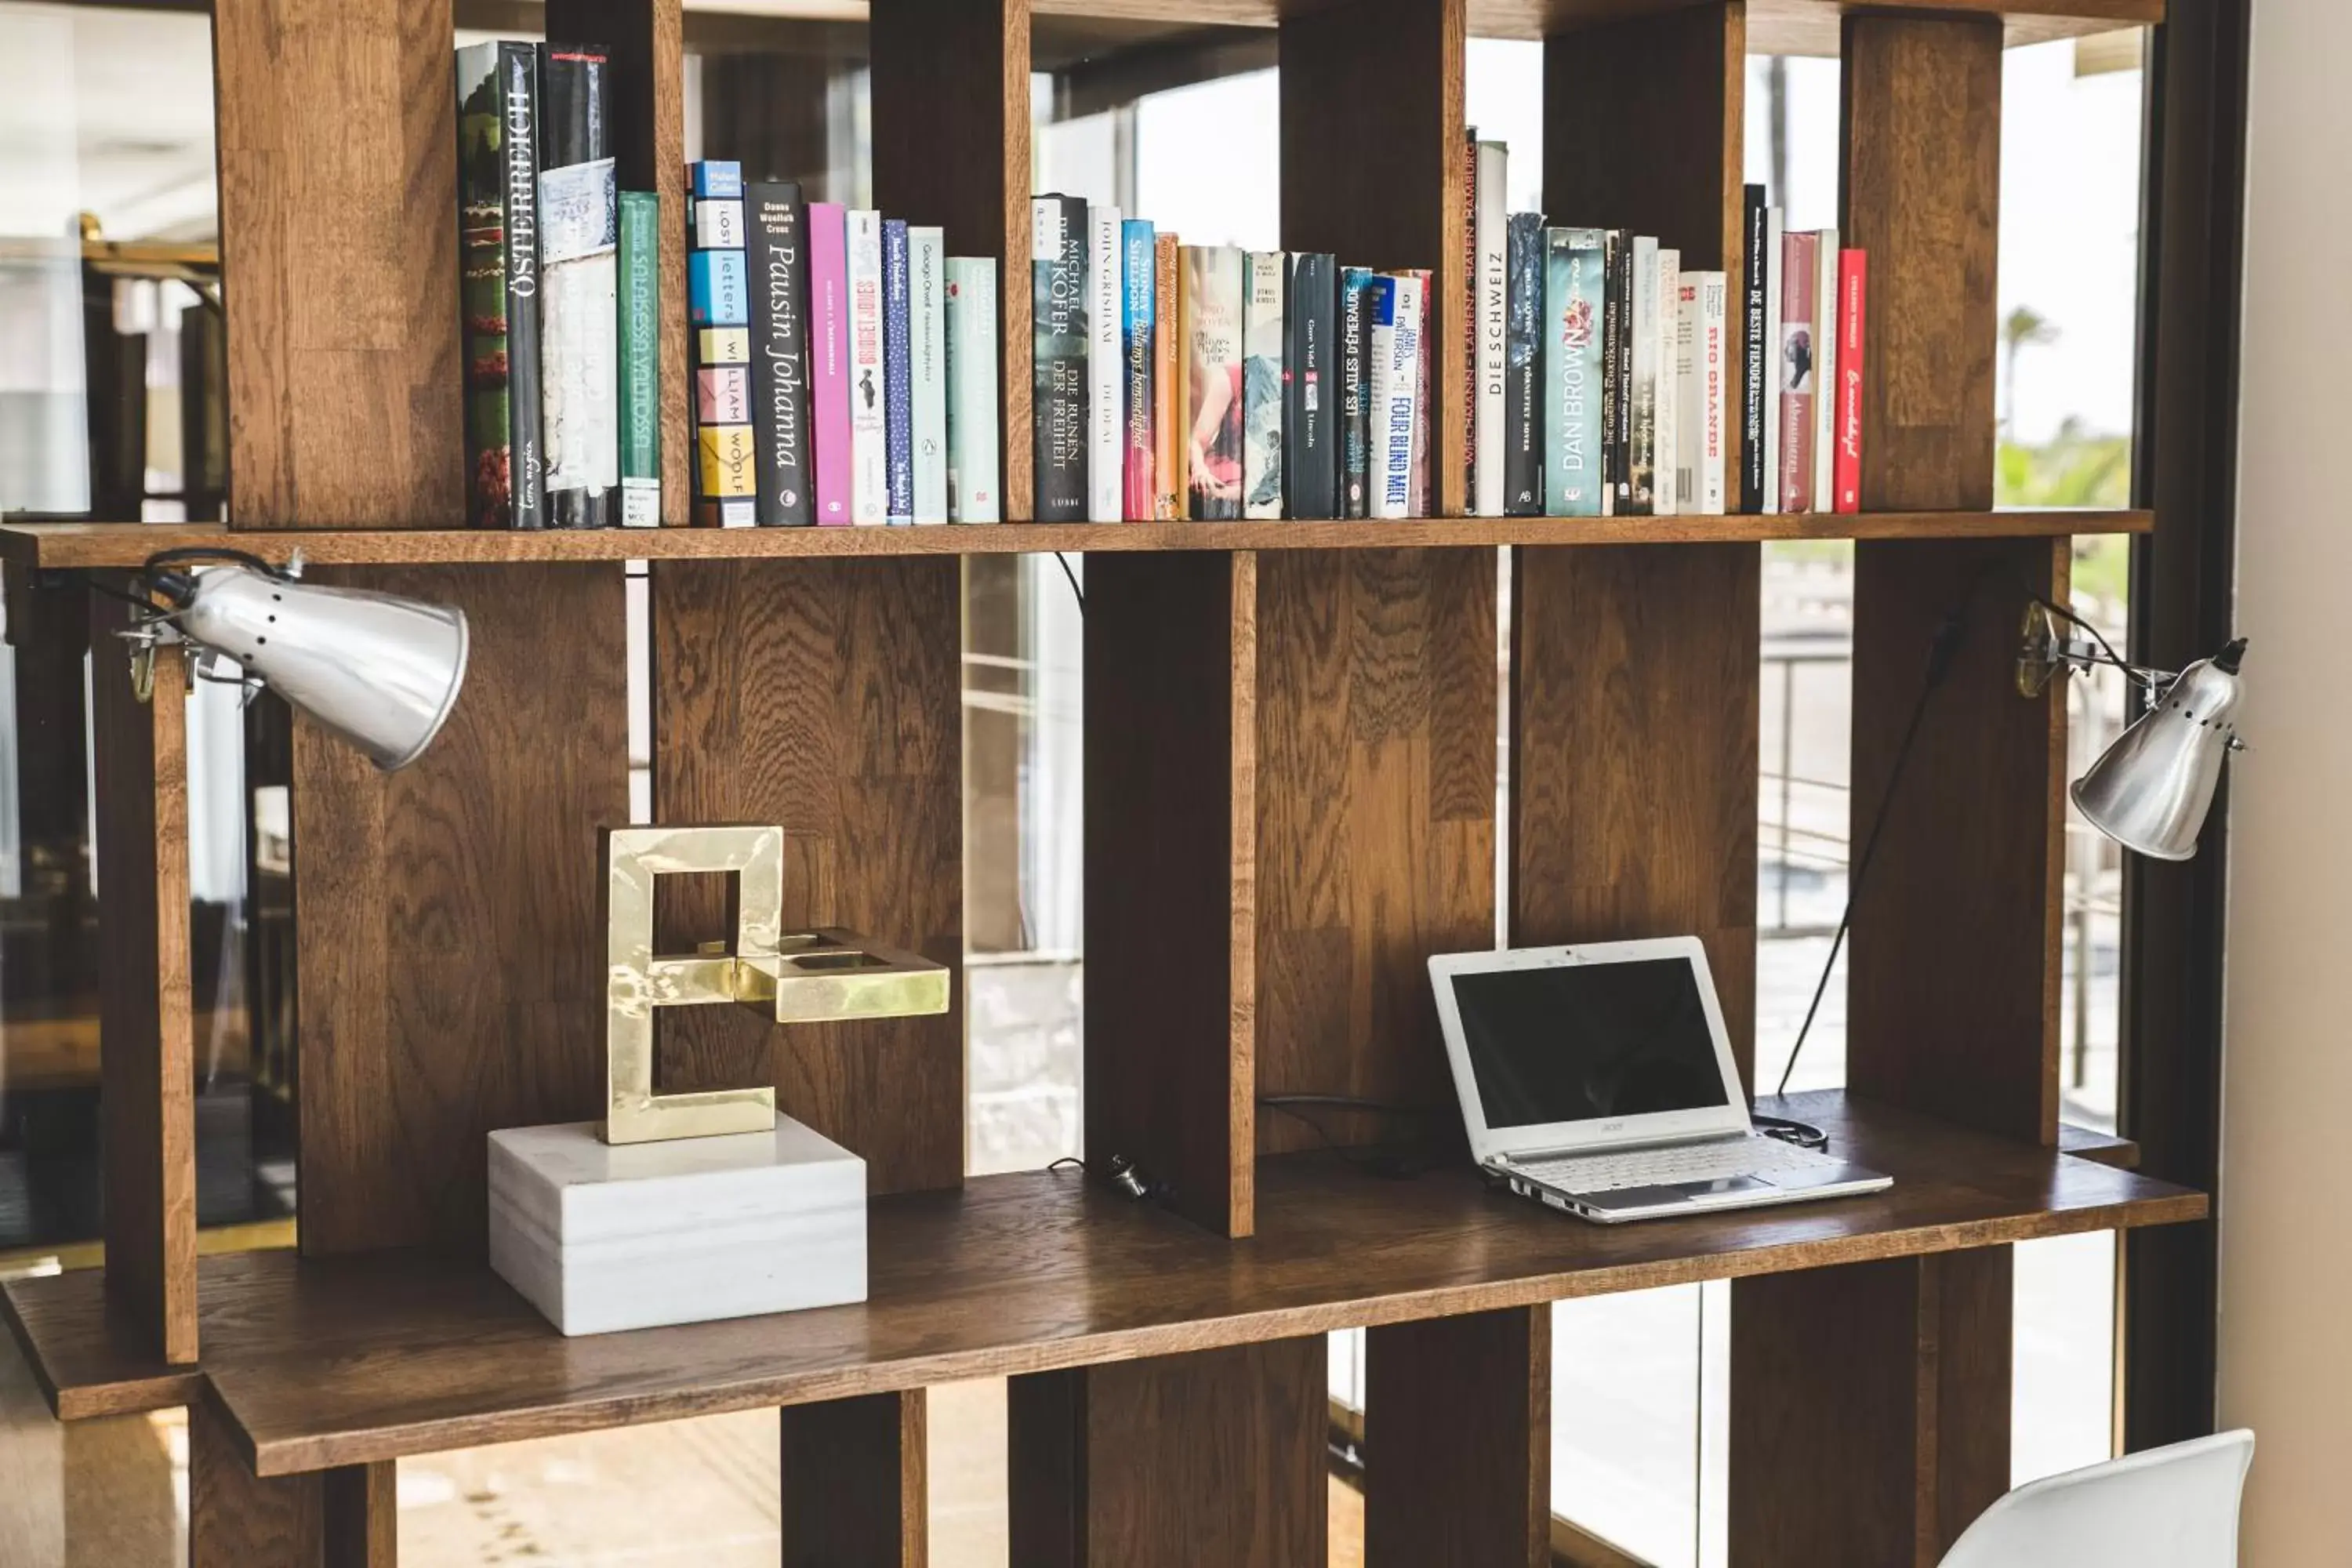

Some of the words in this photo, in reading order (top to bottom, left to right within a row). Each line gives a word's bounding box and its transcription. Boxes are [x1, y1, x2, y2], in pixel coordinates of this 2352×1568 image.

[507, 89, 535, 296] ÖSTERREICH
[1464, 143, 1475, 219] HAMBURG
[720, 210, 731, 245] LOST
[1101, 221, 1113, 264] JOHN
[1465, 225, 1475, 277] HAFEN
[922, 244, 932, 278] George
[1069, 238, 1080, 313] MICHAEL
[1129, 238, 1142, 311] SHELDON
[1140, 257, 1151, 311] SIDNEY
[721, 256, 735, 320] letters
[768, 245, 797, 339] Pausin
[923, 280, 932, 308] Orwell
[1101, 269, 1113, 343] GRISHAM
[1489, 252, 1502, 351] SCHWEIZ
[1750, 289, 1762, 304] DE
[857, 320, 877, 365] BRIDGET
[1131, 318, 1149, 370] Bellamys
[1307, 319, 1316, 343] Gore
[1344, 285, 1359, 354] D'ÉMERAUDE
[1393, 315, 1406, 372] PATTERSON
[1404, 328, 1417, 359] JAMES
[1749, 307, 1762, 340] BESTE
[1307, 343, 1316, 368] Vidal
[1708, 326, 1719, 364] RIO
[1748, 343, 1762, 393] FIENDER
[1054, 360, 1065, 392] DER
[1068, 369, 1078, 397] DIE
[1345, 358, 1359, 392] AILES
[1489, 361, 1501, 396] DIE
[1563, 328, 1584, 416] BROWN
[765, 345, 801, 468] Johanna
[1129, 372, 1149, 449] hemmelighed
[1307, 412, 1316, 448] Lincoln
[1345, 396, 1359, 416] LES
[1390, 397, 1412, 433] FOUR
[1465, 370, 1475, 466] WIECHMANN
[1708, 371, 1719, 458] GRANDE
[1053, 398, 1065, 471] FREIHEIT
[1067, 403, 1078, 461] RUNEN
[1388, 435, 1410, 472] BLIND
[1523, 421, 1532, 452] SOVER
[1563, 421, 1583, 471] DAN
[730, 432, 743, 493] WOOLF
[1385, 474, 1407, 506] MICE
